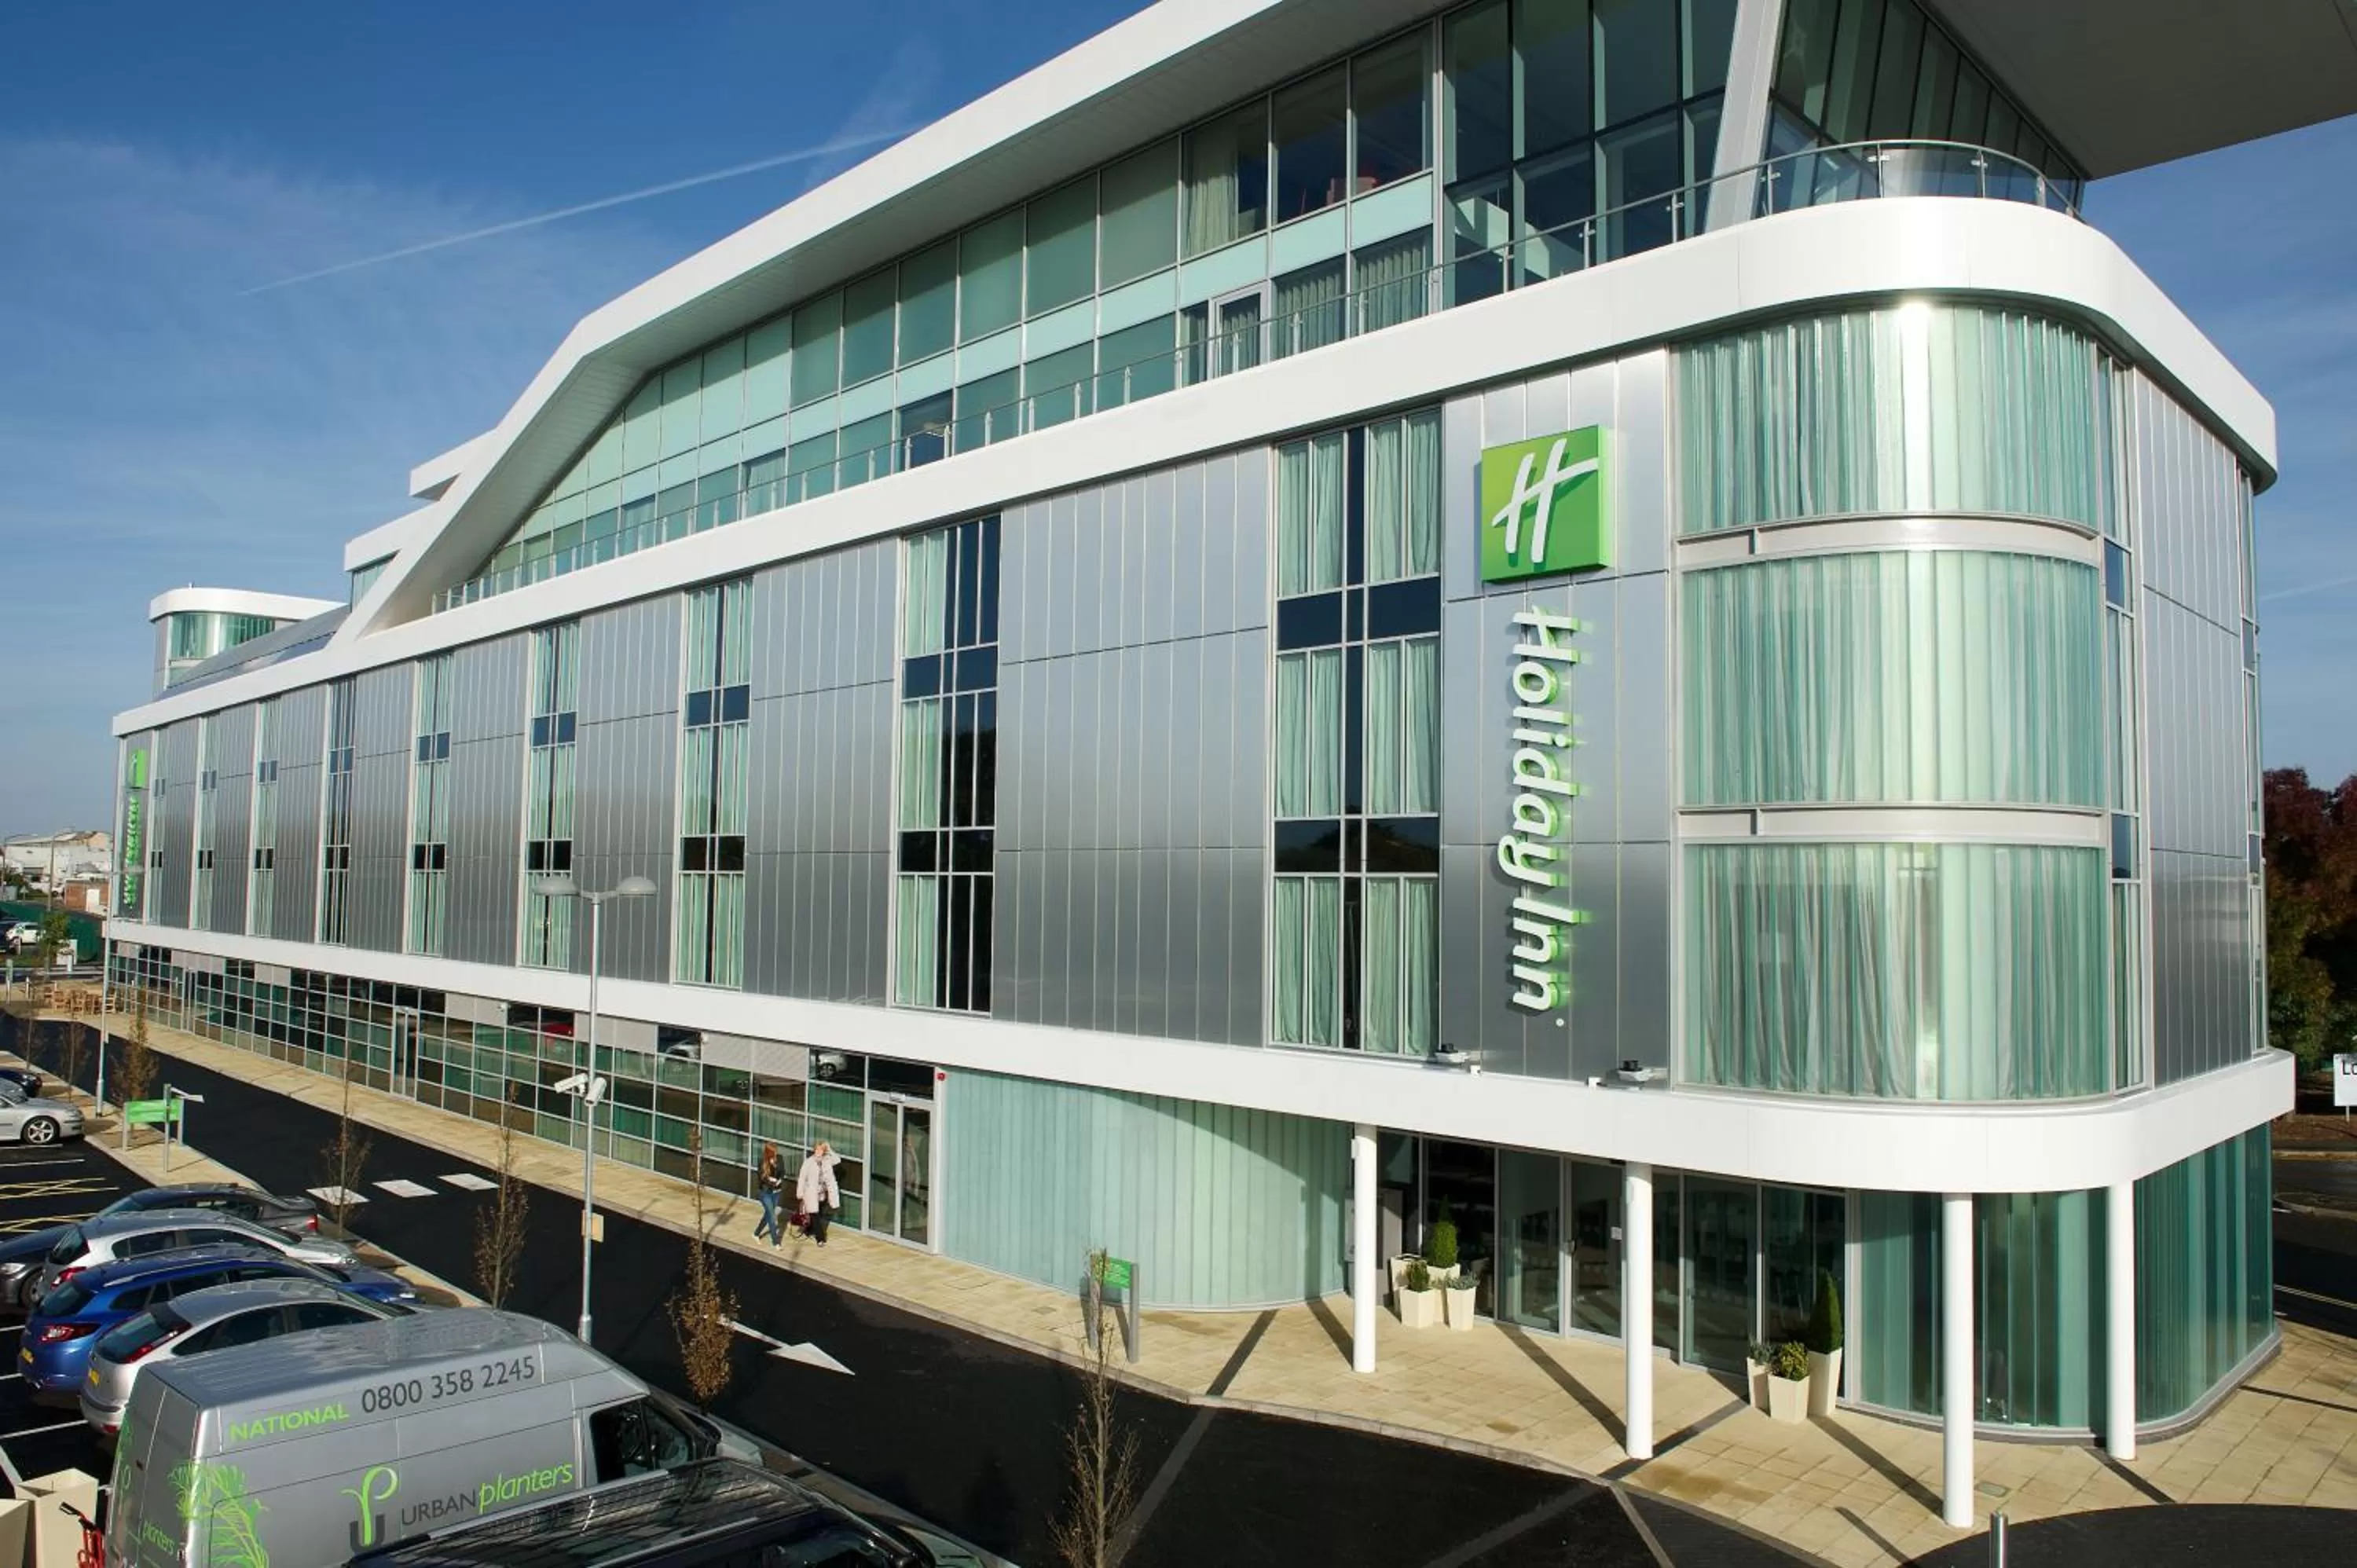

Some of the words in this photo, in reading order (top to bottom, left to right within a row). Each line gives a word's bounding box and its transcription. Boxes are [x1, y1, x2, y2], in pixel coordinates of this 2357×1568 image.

[1497, 604, 1581, 888] Holiday
[1512, 897, 1582, 1011] Inn
[228, 1401, 350, 1442] NATIONAL
[361, 1379, 423, 1414] 0800
[431, 1369, 474, 1400] 358
[480, 1355, 536, 1388] 2245
